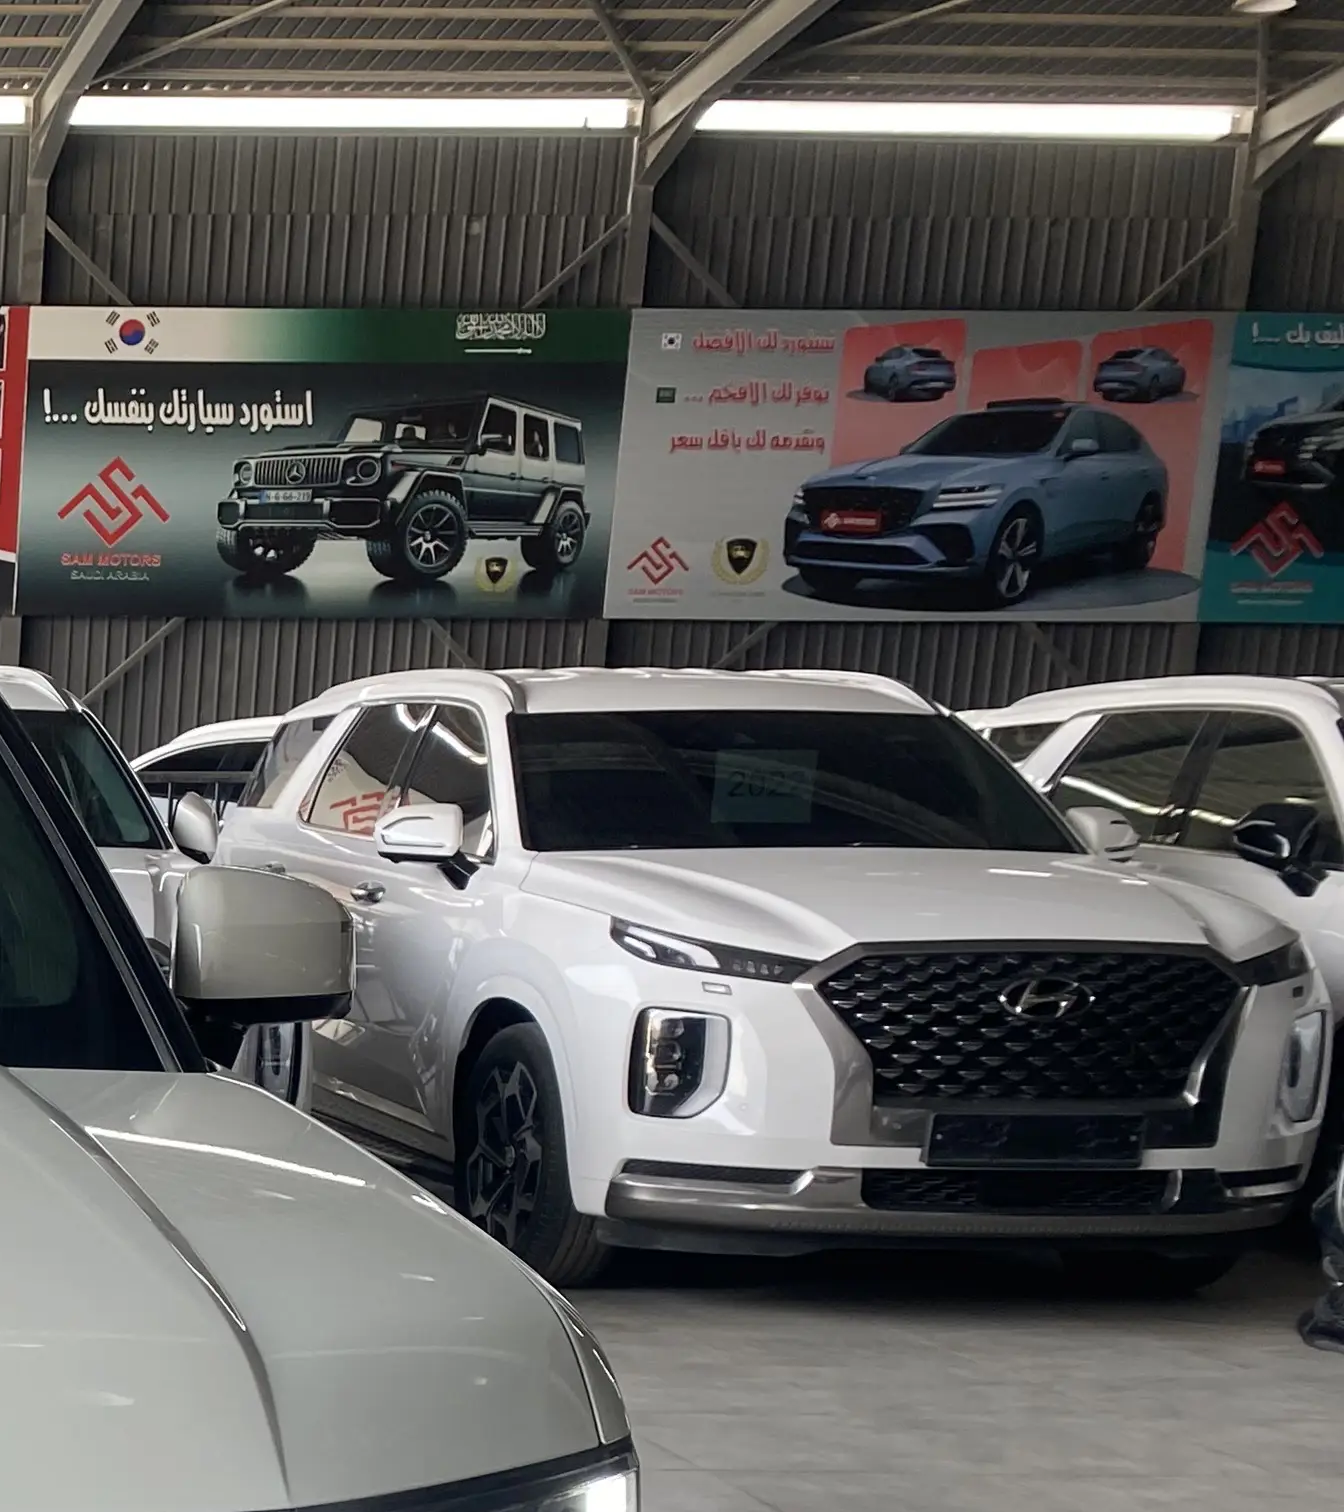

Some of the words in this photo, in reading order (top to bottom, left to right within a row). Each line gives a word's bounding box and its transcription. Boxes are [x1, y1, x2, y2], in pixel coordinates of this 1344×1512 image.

[84, 387, 155, 432] بنفسك
[160, 387, 235, 434] سيارتك
[239, 389, 313, 433] استورد
[61, 552, 93, 567] SAM
[98, 553, 162, 567] MOTORS
